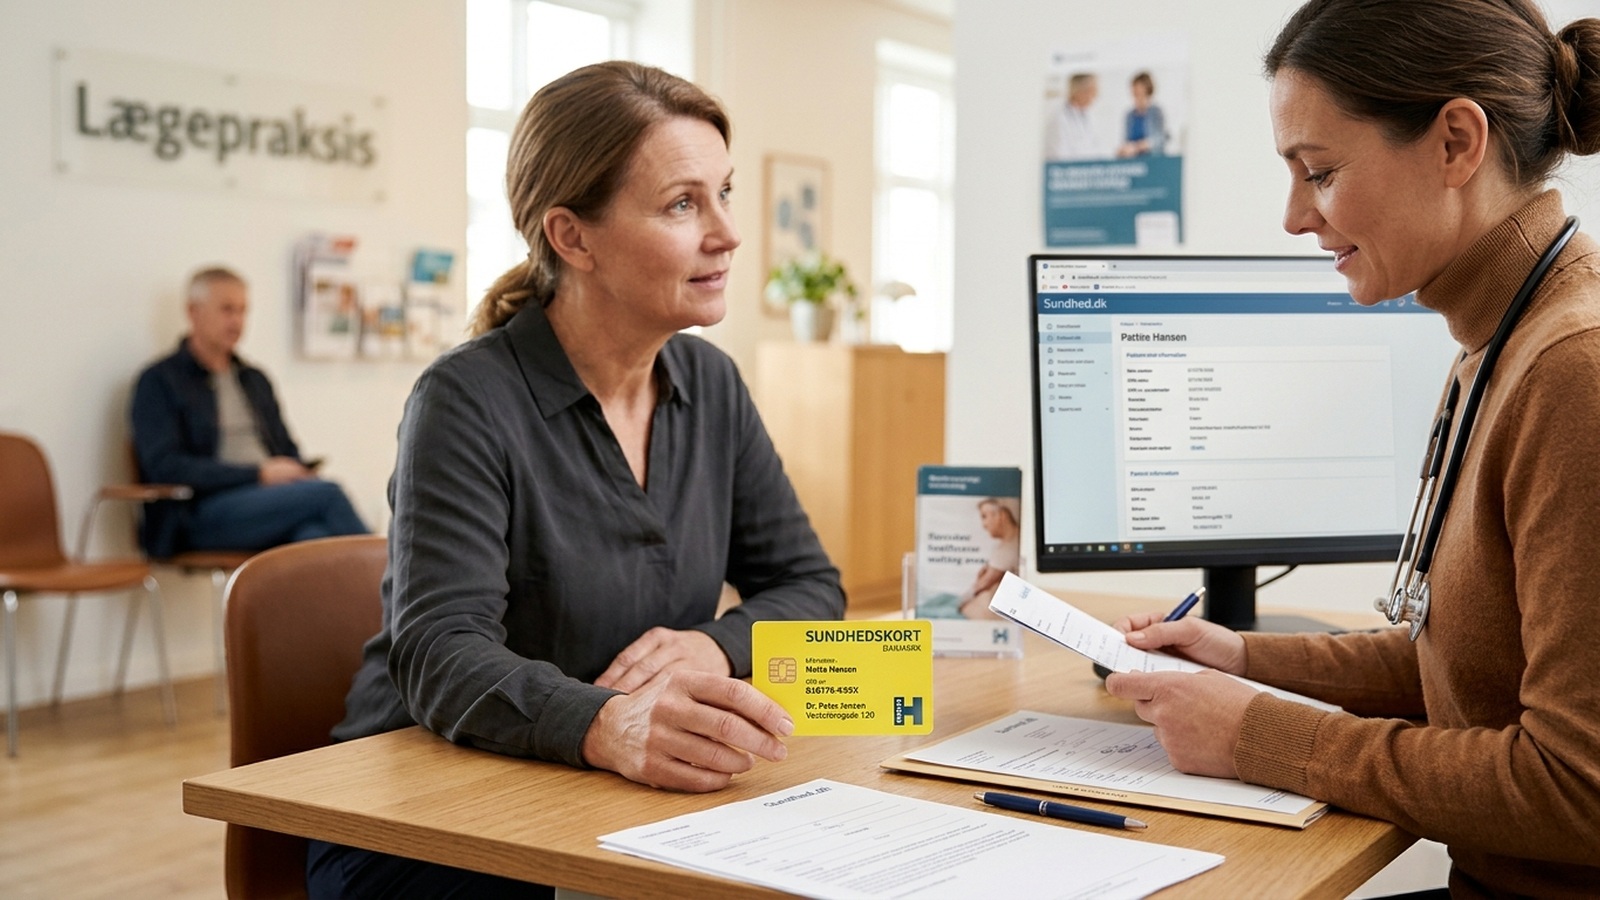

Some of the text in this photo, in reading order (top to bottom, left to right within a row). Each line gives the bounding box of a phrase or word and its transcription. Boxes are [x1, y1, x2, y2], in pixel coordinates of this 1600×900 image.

[75, 82, 377, 168] Lægepraksis
[1043, 298, 1107, 309] Sundhed.dk
[1153, 333, 1187, 342] Hansen
[806, 630, 922, 643] SUNDHEDSKORT
[806, 702, 817, 710] Dr.
[861, 711, 875, 719] 120
